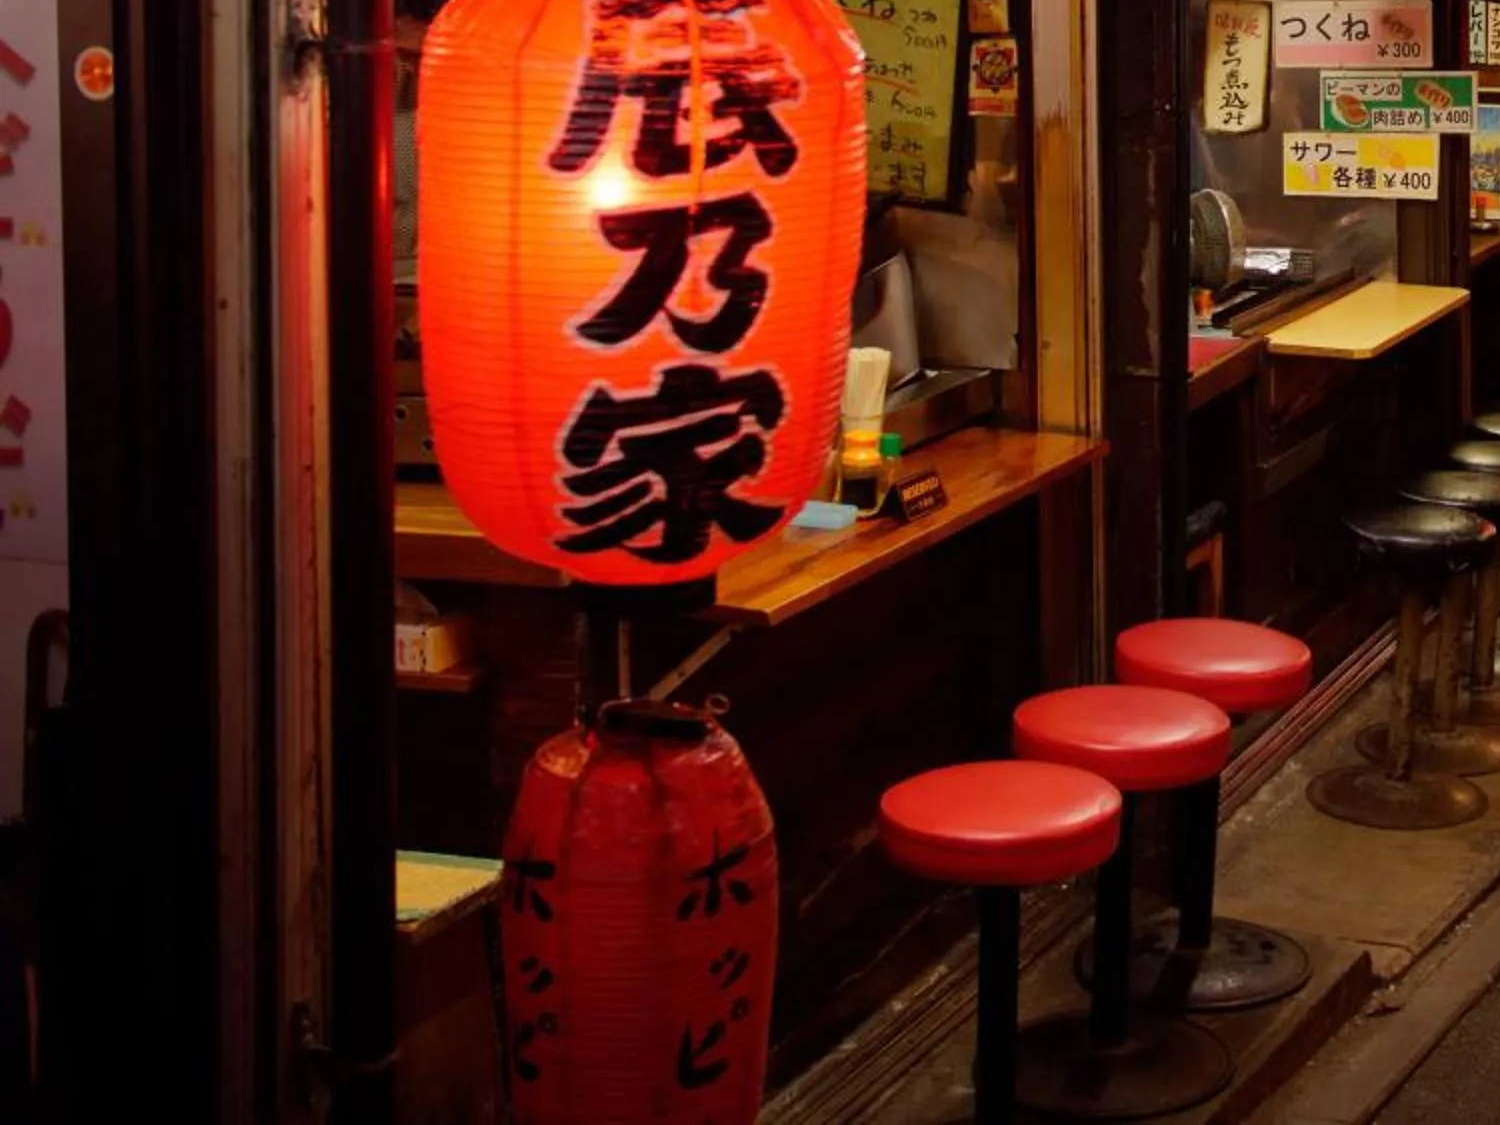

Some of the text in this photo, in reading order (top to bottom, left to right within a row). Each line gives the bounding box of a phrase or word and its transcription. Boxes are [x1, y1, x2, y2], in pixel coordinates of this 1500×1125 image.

[1280, 11, 1370, 43] つくね
[1376, 43, 1421, 58] ¥300
[1374, 110, 1470, 126] 肉詰め ¥400
[1290, 140, 1356, 162] サワー
[1333, 166, 1431, 190] 各種 ¥400
